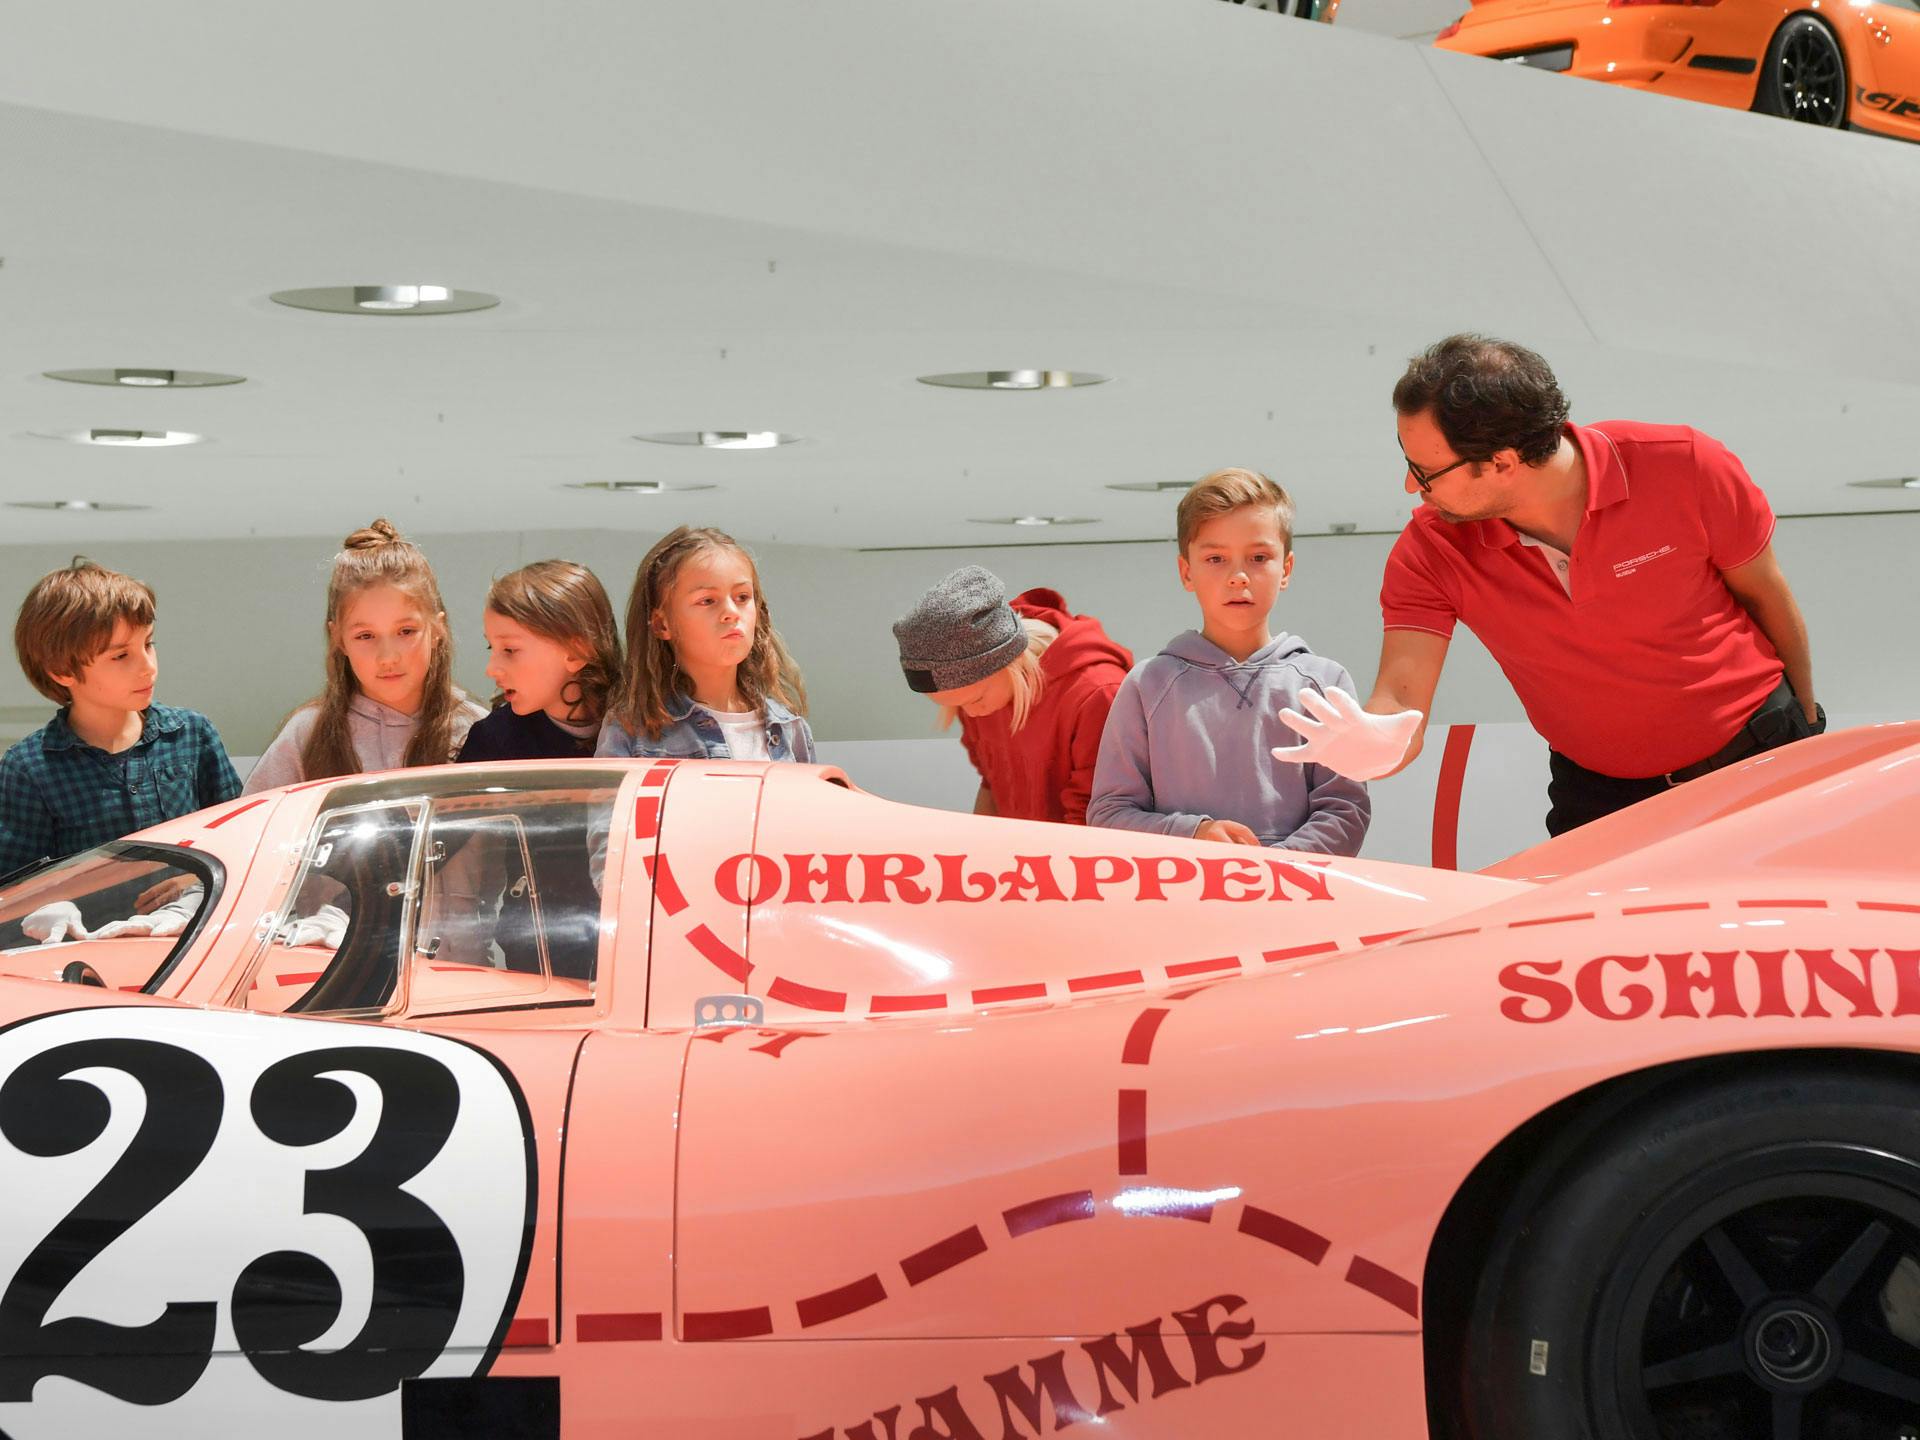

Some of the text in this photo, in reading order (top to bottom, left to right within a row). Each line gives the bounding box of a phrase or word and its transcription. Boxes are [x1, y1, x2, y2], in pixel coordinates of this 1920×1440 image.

[1613, 545, 1671, 571] PORSCHE
[714, 853, 1334, 906] OHRLAPPEN
[0, 1038, 465, 1406] 23
[798, 1294, 1266, 1440] AMME
